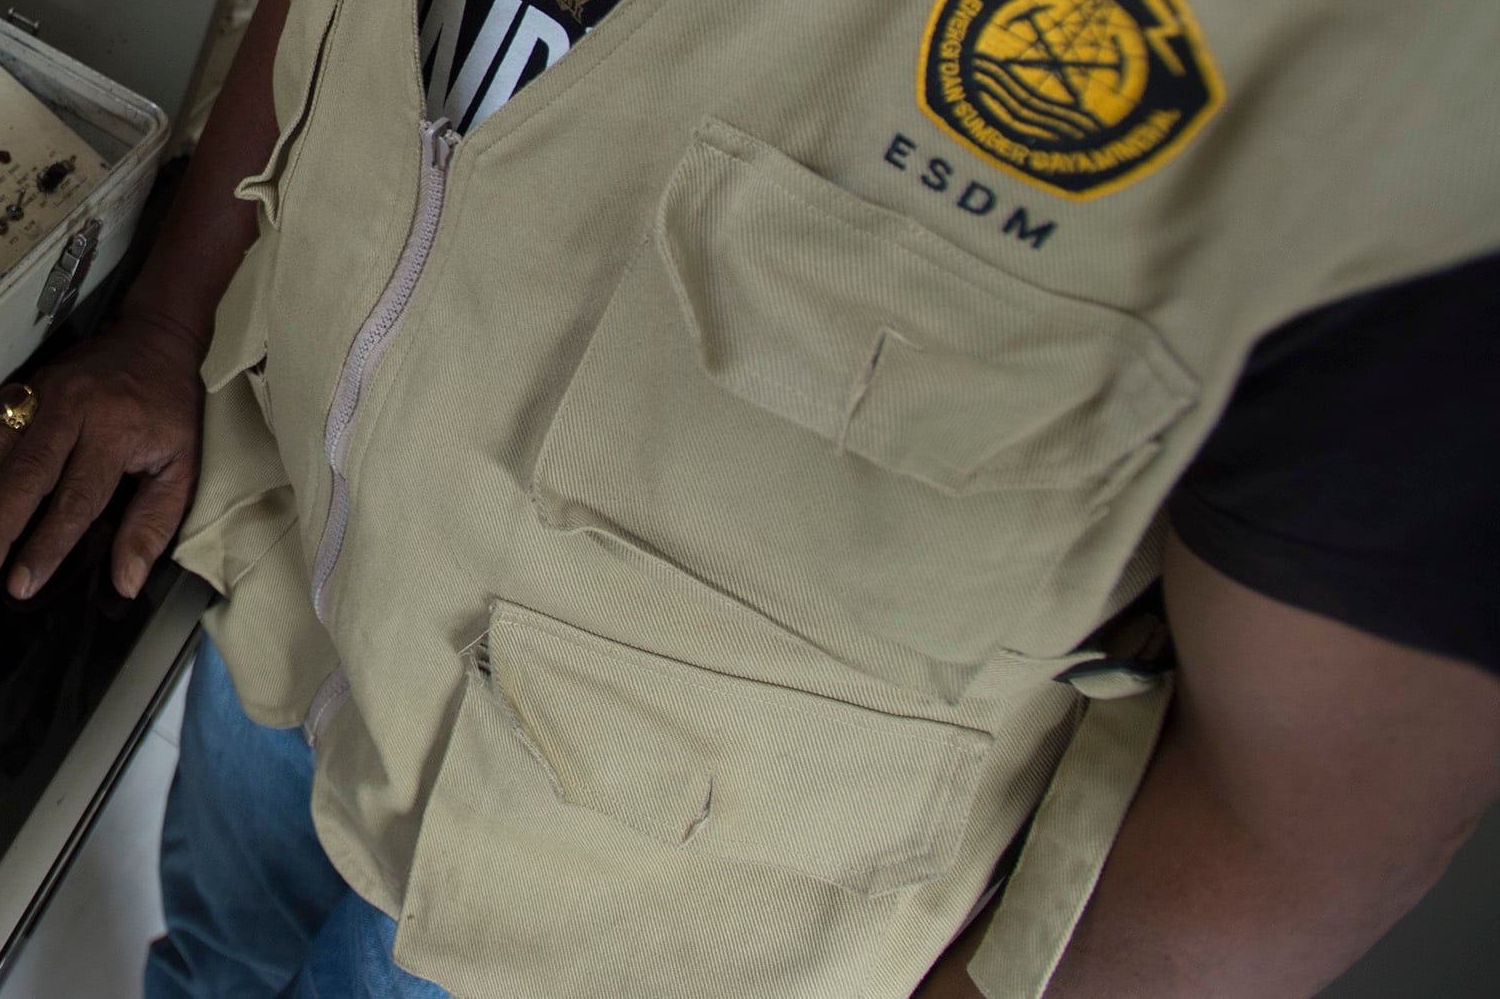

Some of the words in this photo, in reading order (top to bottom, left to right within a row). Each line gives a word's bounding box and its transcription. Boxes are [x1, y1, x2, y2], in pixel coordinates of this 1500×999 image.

[938, 62, 967, 103] DAN
[954, 102, 1032, 165] SUMBER
[883, 132, 1059, 250] ESDM
